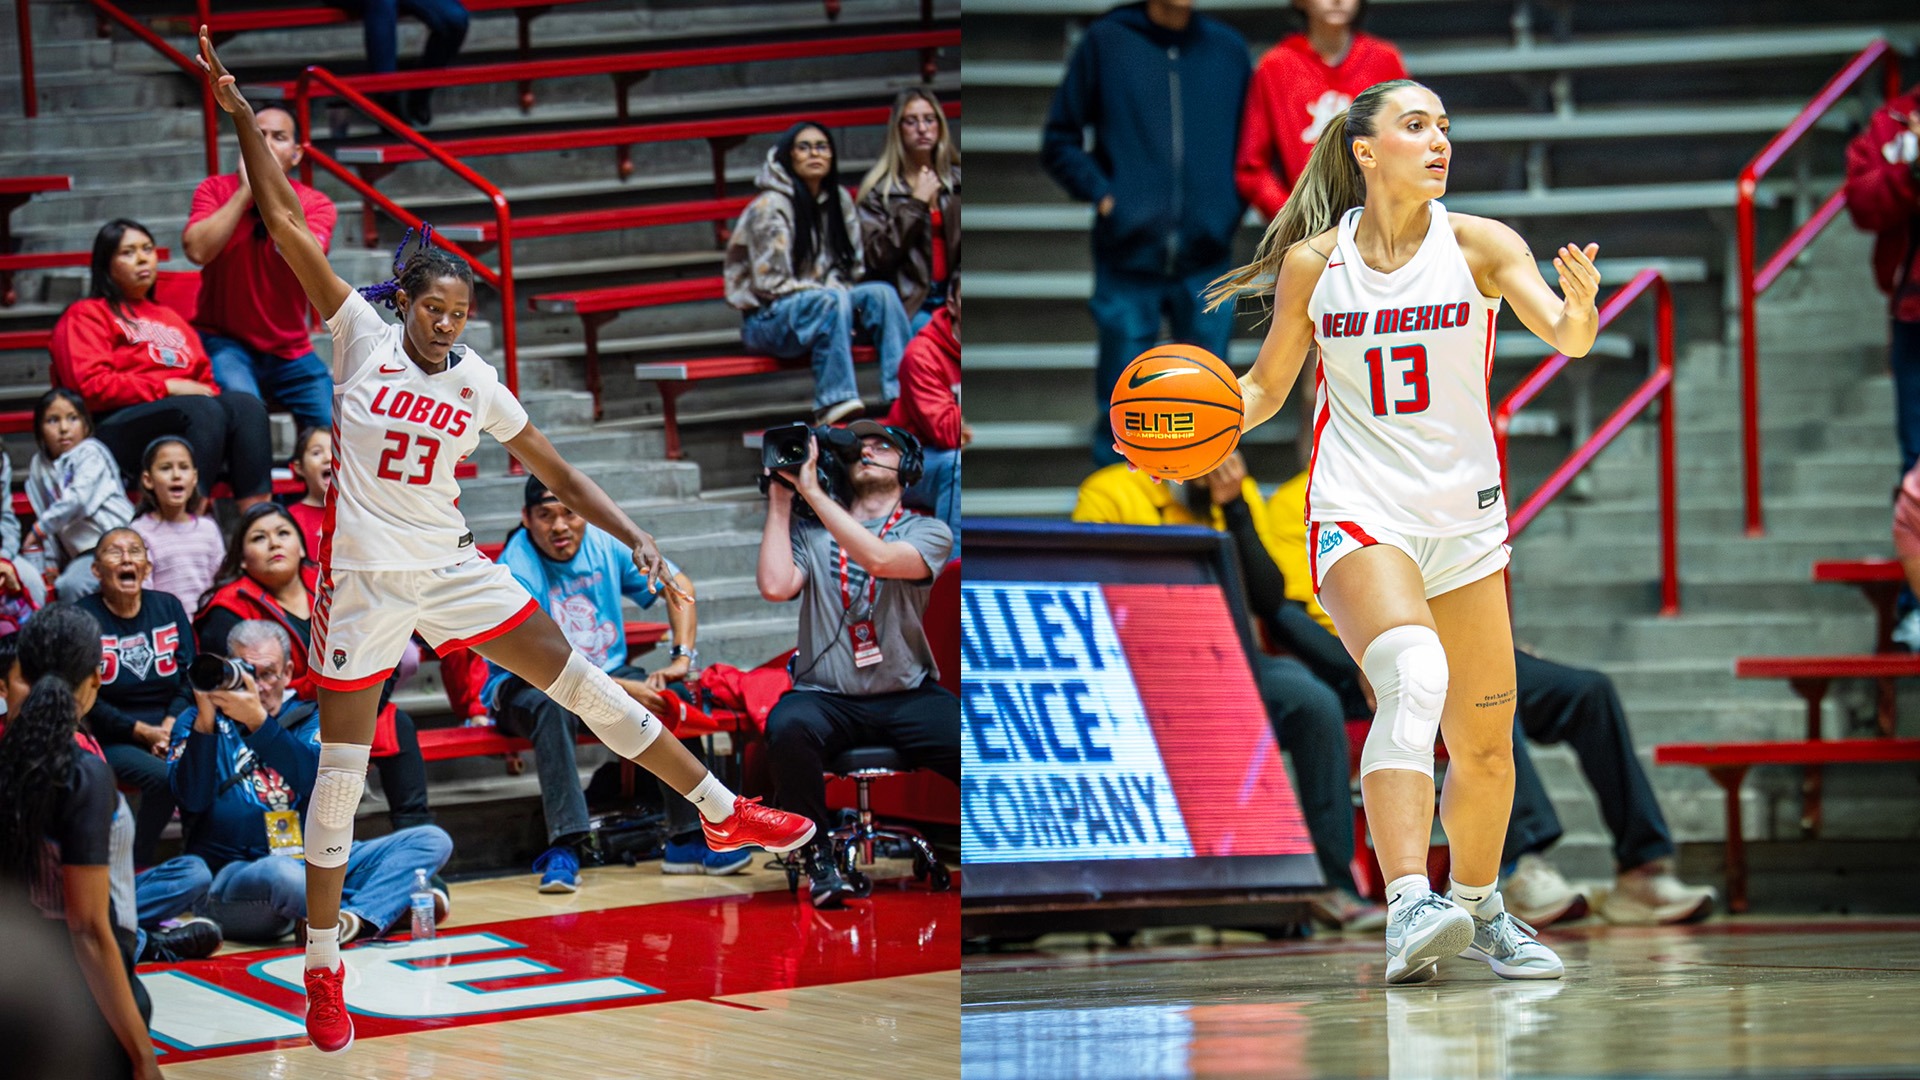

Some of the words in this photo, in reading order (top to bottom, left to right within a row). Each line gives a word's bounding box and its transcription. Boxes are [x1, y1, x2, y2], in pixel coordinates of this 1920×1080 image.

[1322, 312, 1369, 338] NEW
[1373, 301, 1471, 335] MEXICO
[1363, 342, 1431, 417] 13
[370, 386, 473, 438] LOBOS
[1124, 411, 1195, 432] ELITE
[1125, 431, 1195, 439] CHAMPIONSHIP
[377, 429, 441, 485] 23
[961, 774, 1168, 848] COMPANY
